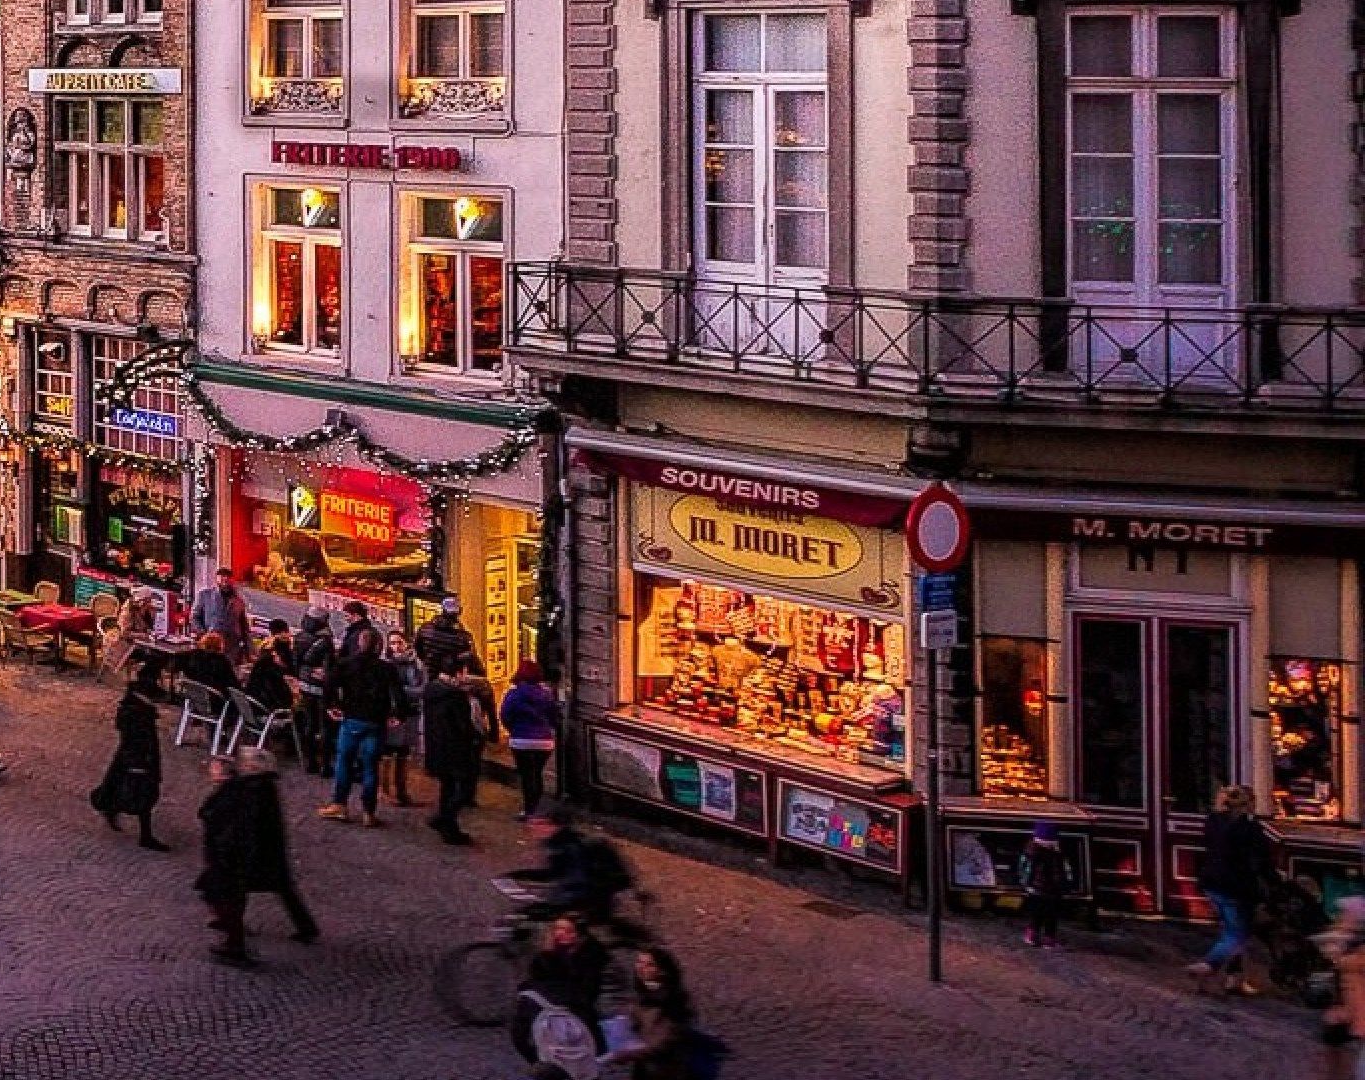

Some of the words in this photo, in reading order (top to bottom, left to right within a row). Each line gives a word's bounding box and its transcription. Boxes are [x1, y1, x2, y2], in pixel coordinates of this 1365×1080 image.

[272, 140, 392, 168] FRITERIE
[393, 146, 461, 170] 1900
[660, 467, 819, 509] SOUVENIRS
[322, 494, 390, 524] FRITERIE
[355, 522, 390, 542] 1900
[733, 523, 844, 568] MORET
[1072, 518, 1115, 538] M.
[1127, 522, 1273, 546] MORET
